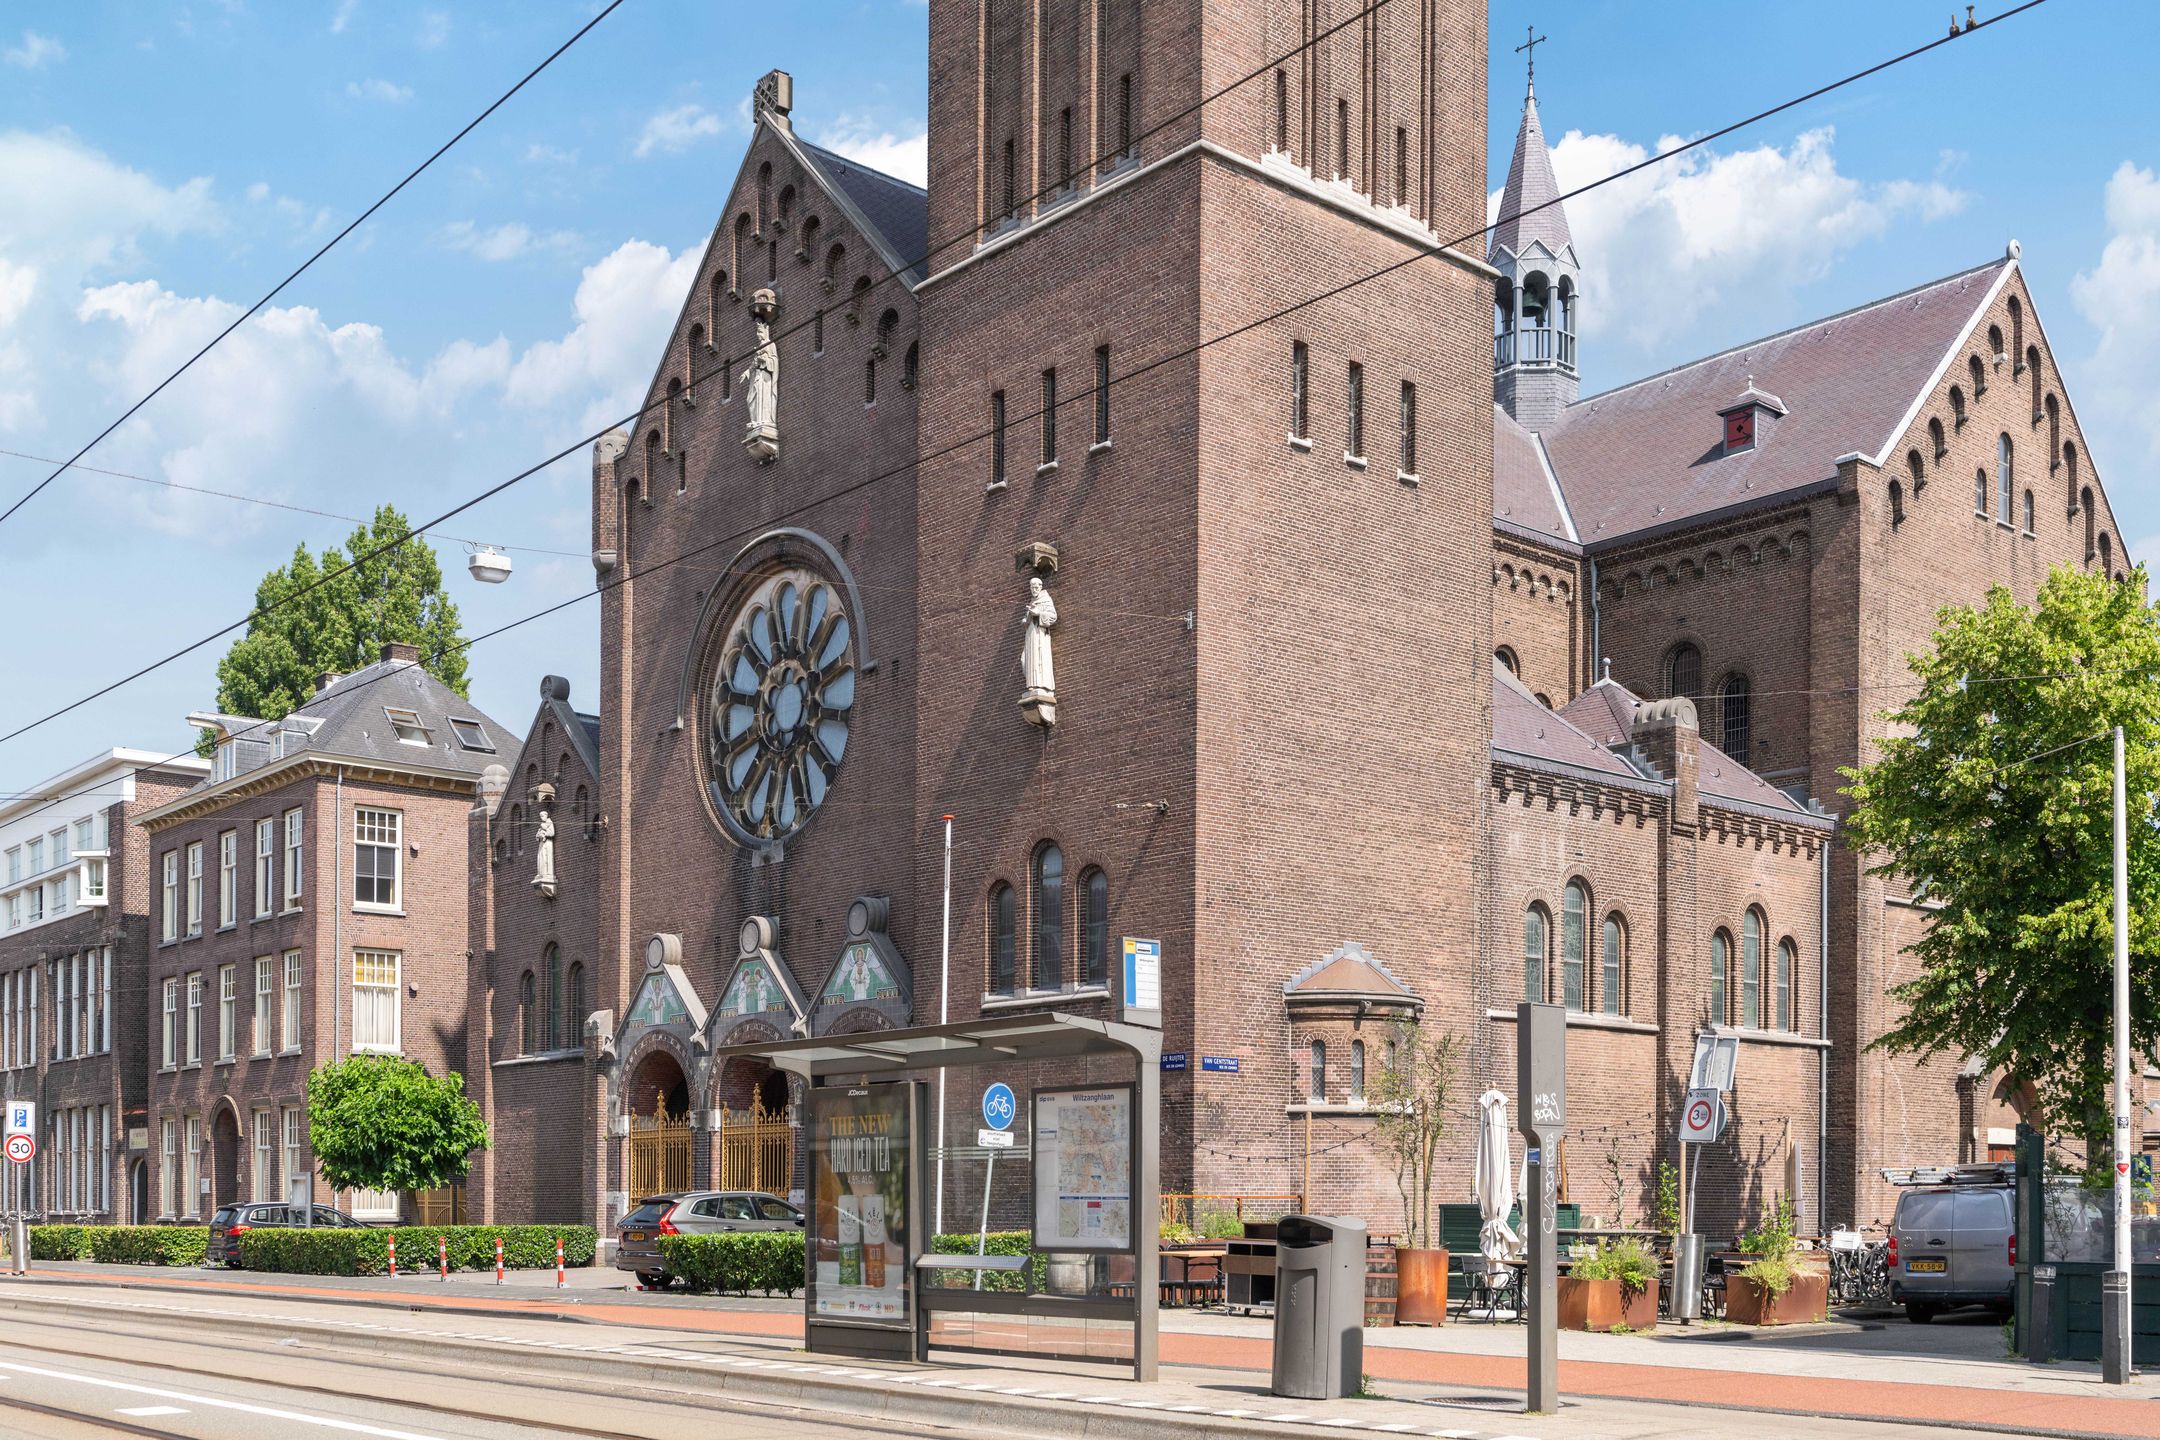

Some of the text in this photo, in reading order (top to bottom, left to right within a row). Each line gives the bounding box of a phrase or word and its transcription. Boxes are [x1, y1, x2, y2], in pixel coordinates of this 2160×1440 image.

[1072, 1093, 1114, 1102] Wiltzanghlaan
[830, 1114, 891, 1136] THE NEW
[11, 1143, 30, 1154] 30
[831, 1136, 891, 1173] HARD ICED TEA
